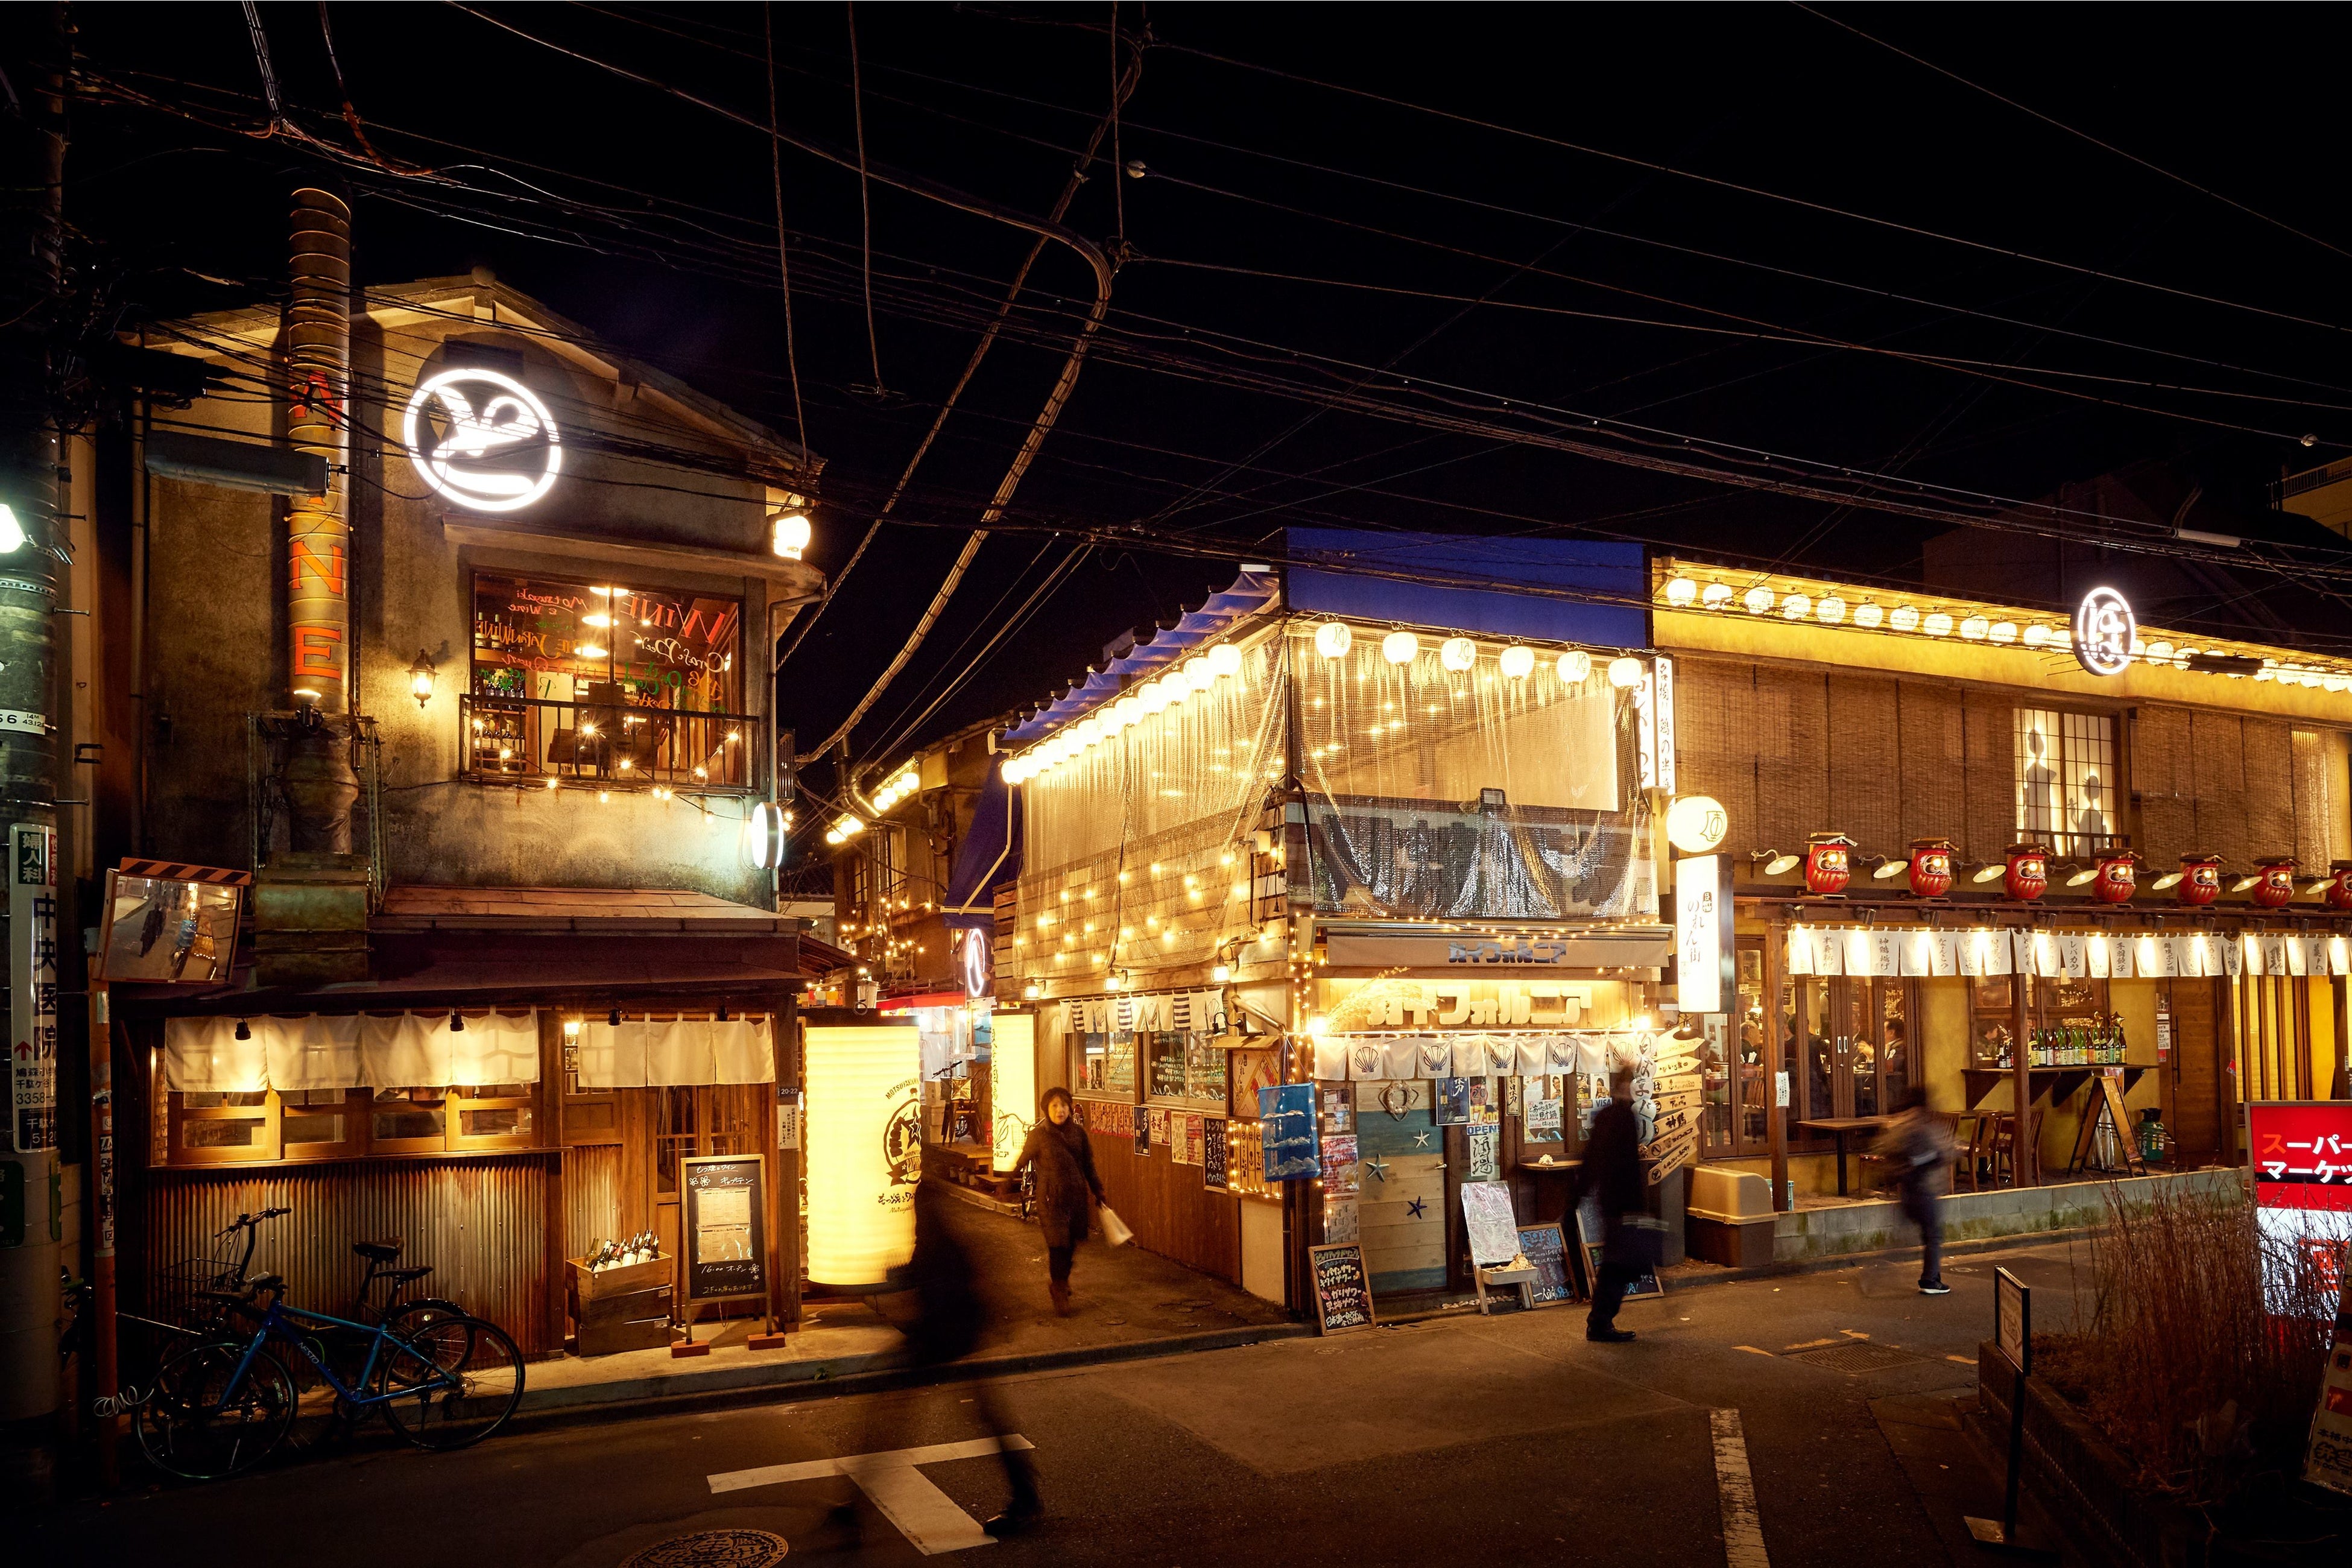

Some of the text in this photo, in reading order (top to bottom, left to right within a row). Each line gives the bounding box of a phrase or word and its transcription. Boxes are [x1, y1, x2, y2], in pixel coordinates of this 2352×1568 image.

[23, 833, 43, 883] 婦人科
[1449, 941, 1566, 964] カイフォルニア
[2070, 940, 2079, 971] レバカツ
[33, 893, 57, 1060] 中央医院
[1596, 1098, 1611, 1107] VISA
[1206, 1120, 1225, 1131] レンタル
[1473, 1136, 1493, 1175] 酒場
[720, 1176, 754, 1185] キャプテン
[726, 1265, 747, 1273] オープン
[1320, 1274, 1352, 1288] キウイサワー
